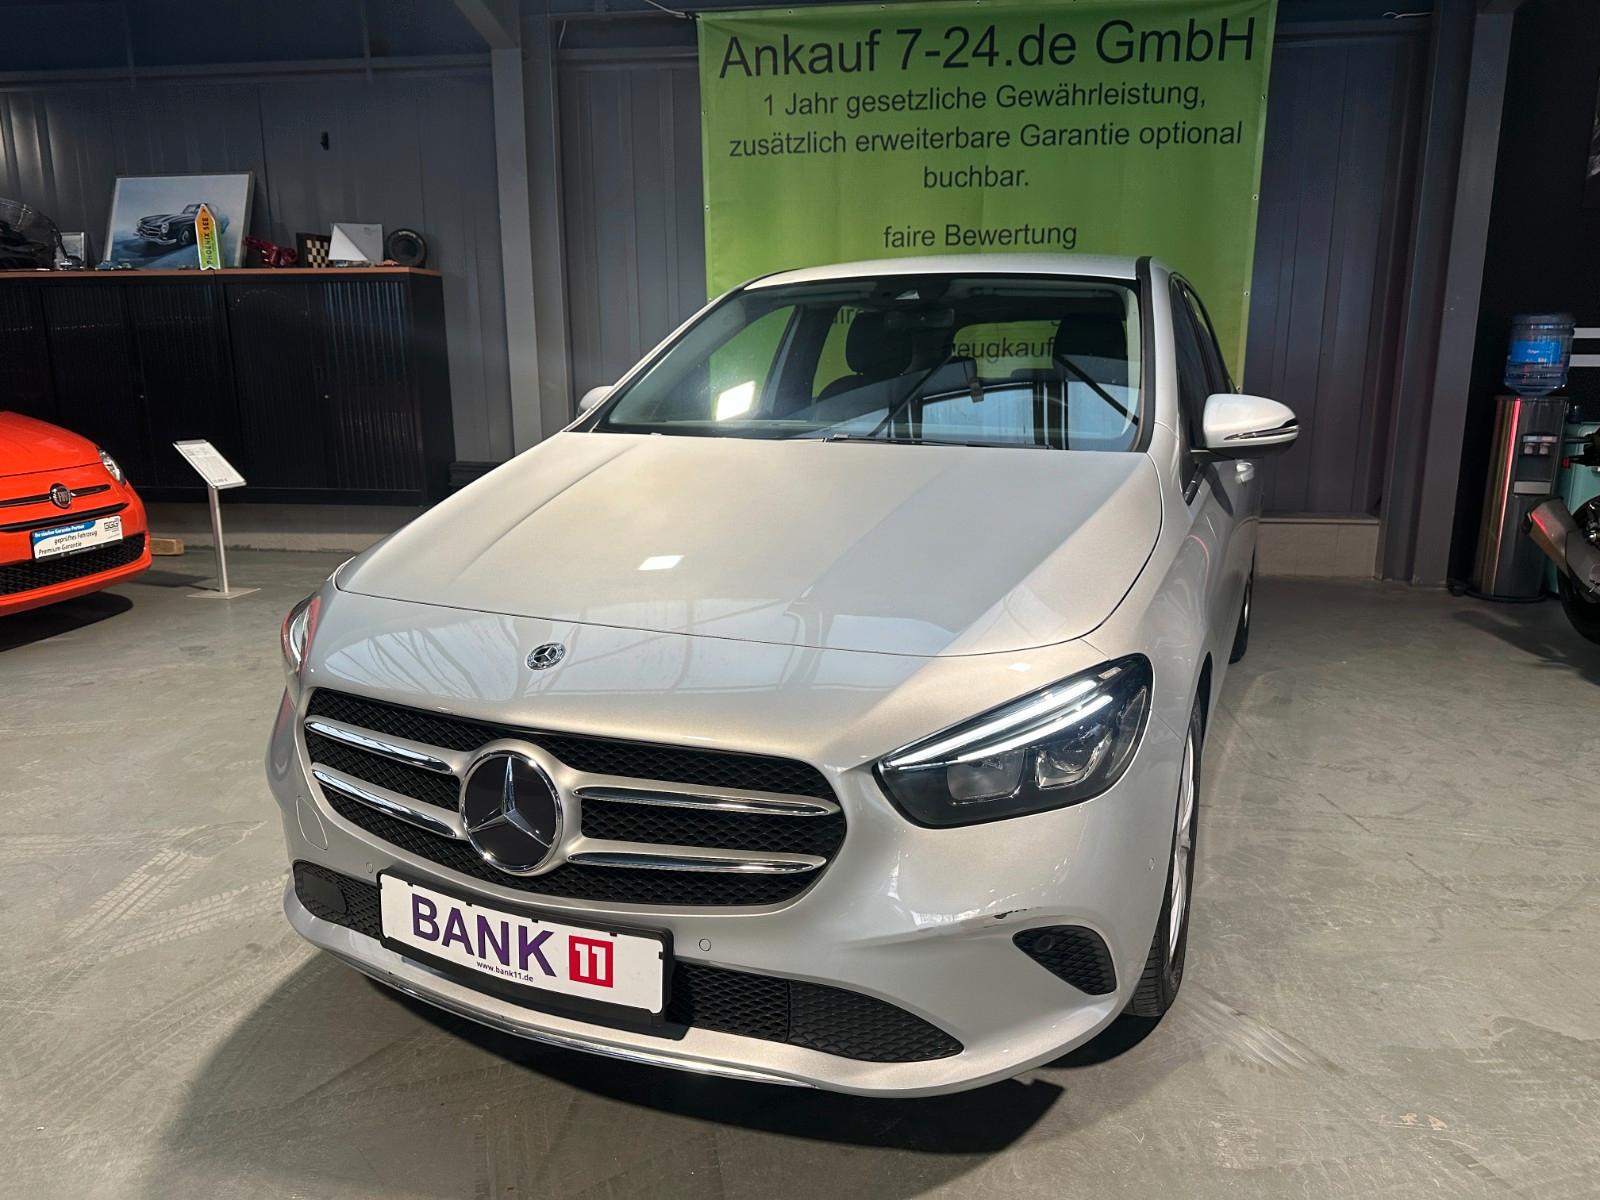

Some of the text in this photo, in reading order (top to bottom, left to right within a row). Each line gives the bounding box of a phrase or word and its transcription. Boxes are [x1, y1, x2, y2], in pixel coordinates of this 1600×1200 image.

[720, 17, 1254, 78] Ankauf 7-24.de GmbH
[763, 82, 1205, 119] 1 Jahr gesetzliche Gewährleistung,
[730, 121, 1242, 156] zusätzlich erweiterbare Garantie optional
[924, 165, 1028, 188] buchbar.
[202, 217, 210, 230] SEE
[883, 224, 1077, 250] faire Bewertung
[411, 892, 607, 981] BANK 11
[476, 960, 534, 982] www.bank11.de
